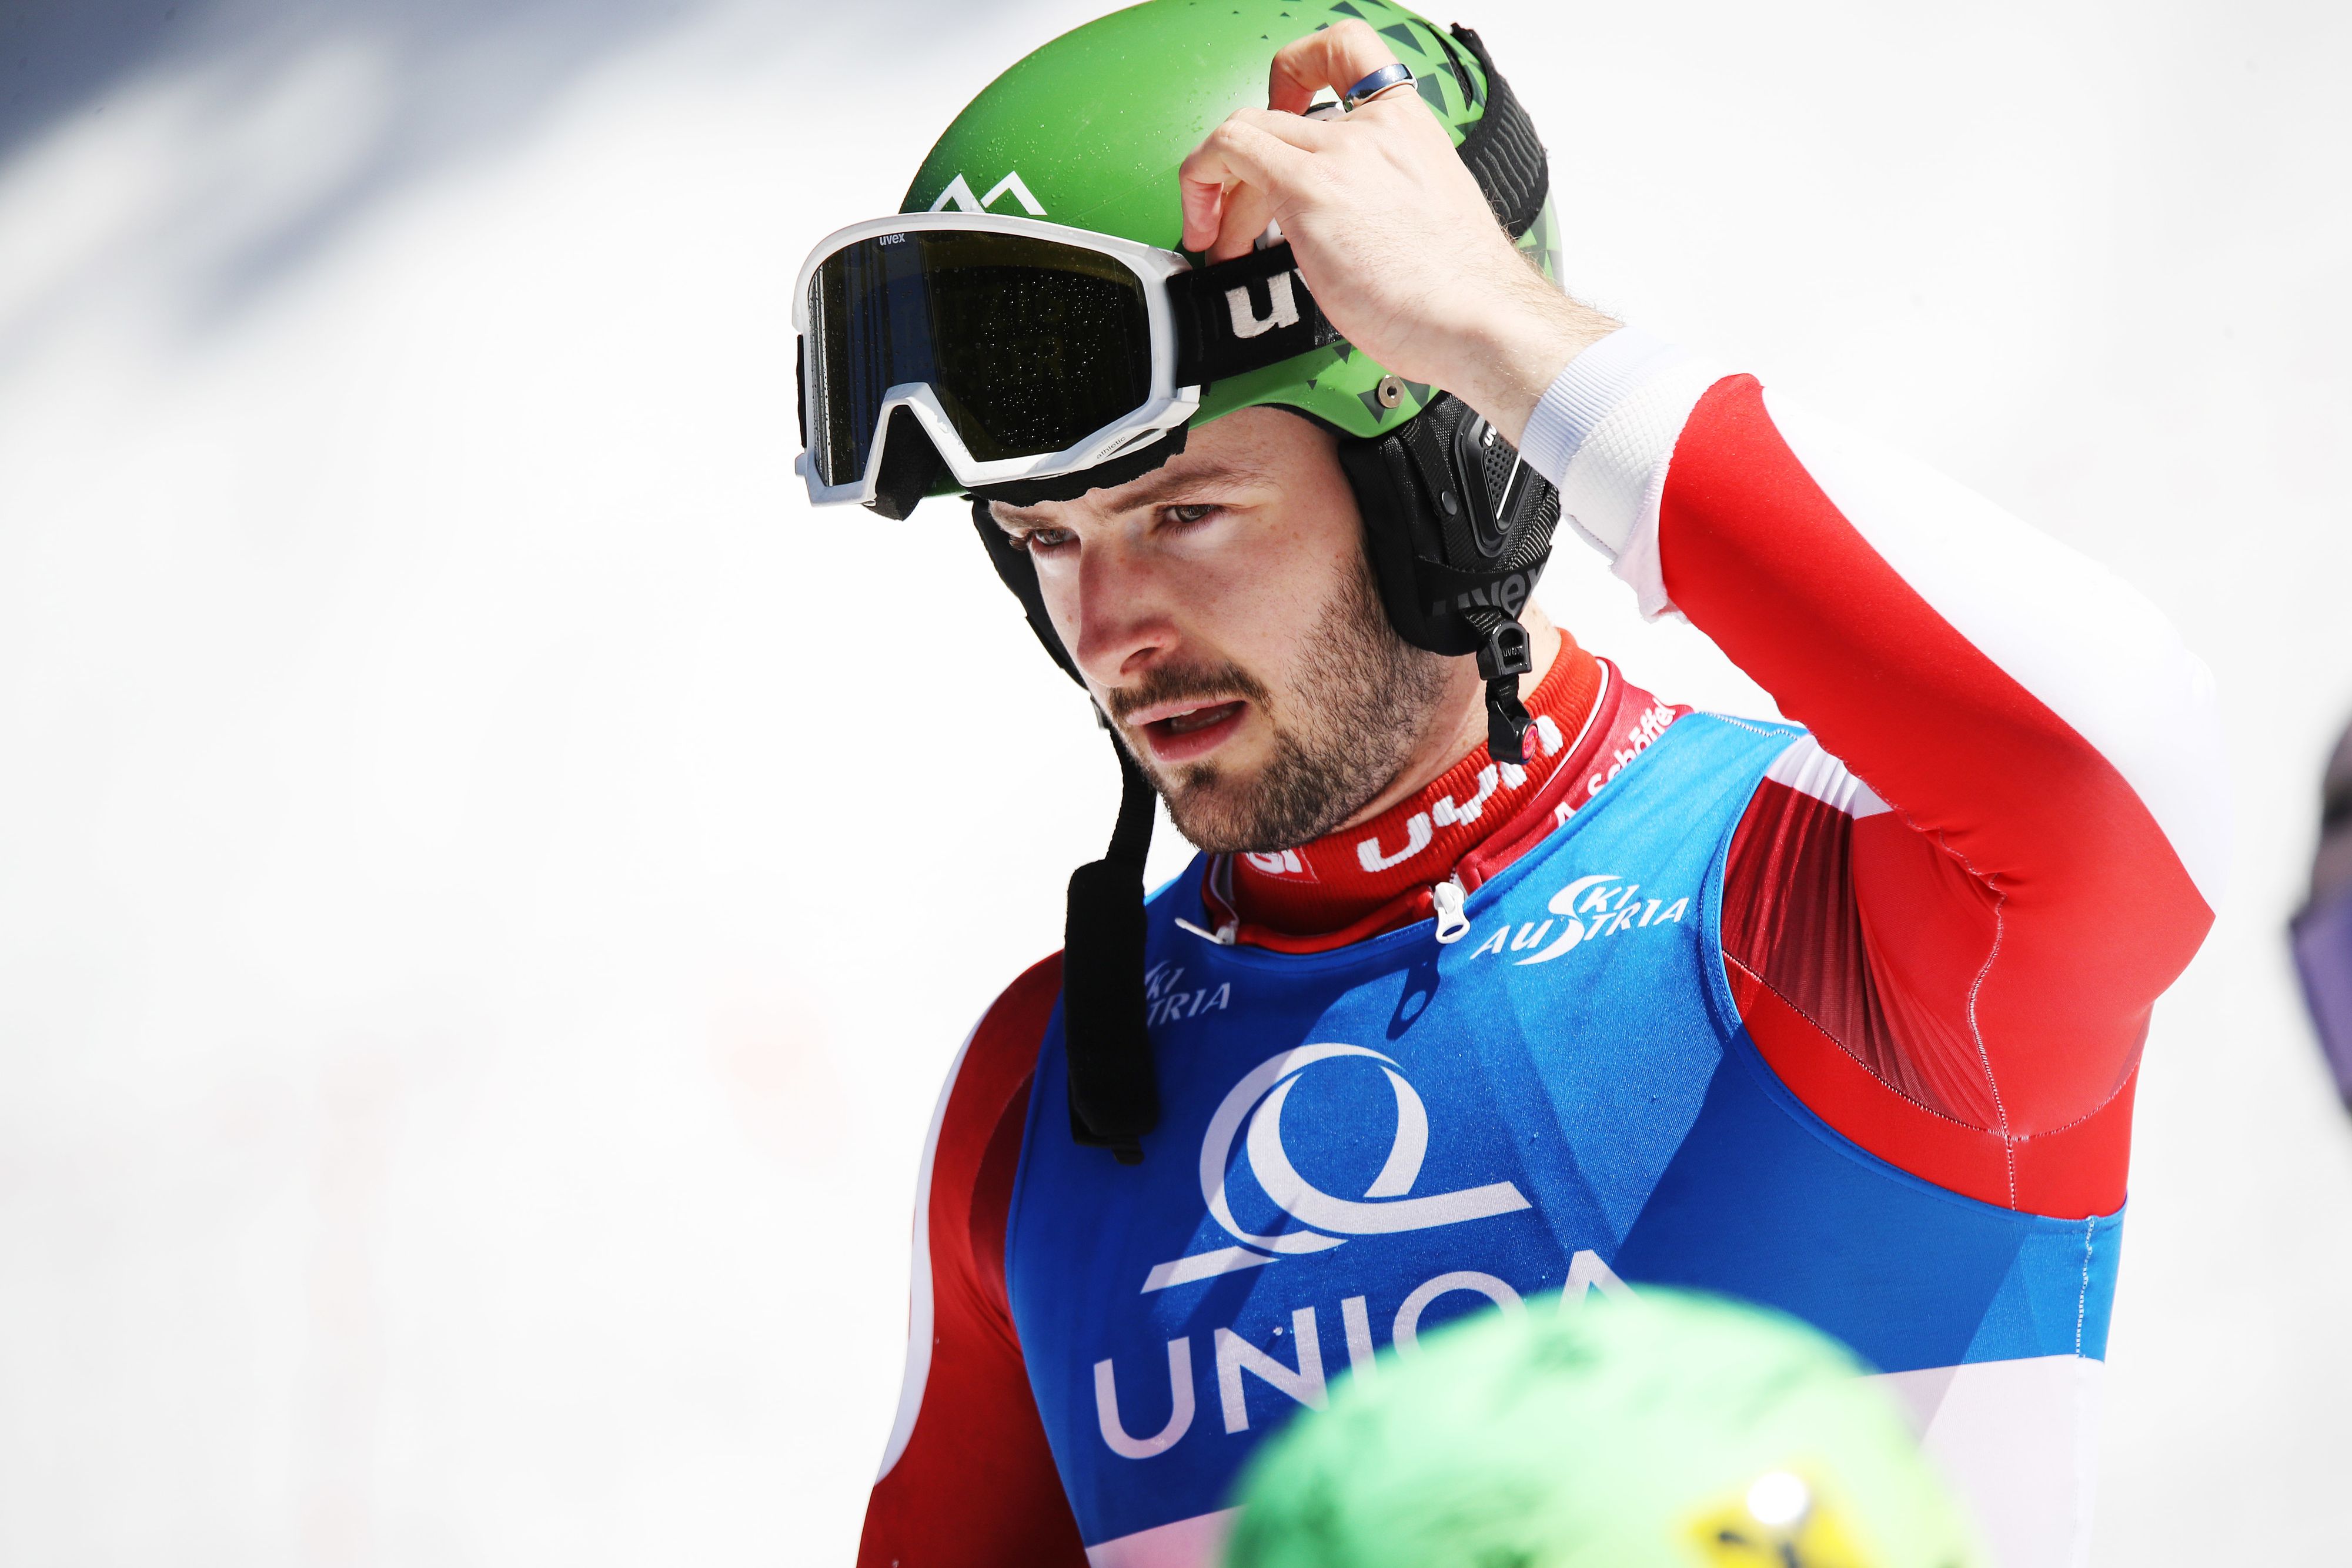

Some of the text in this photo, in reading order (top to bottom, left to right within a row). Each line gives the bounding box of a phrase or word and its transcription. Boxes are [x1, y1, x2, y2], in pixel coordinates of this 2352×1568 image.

[880, 233, 906, 246] uvex
[1225, 268, 1311, 339] u
[1097, 437, 1126, 459] athletic
[1470, 897, 1689, 965] AUSTRIA
